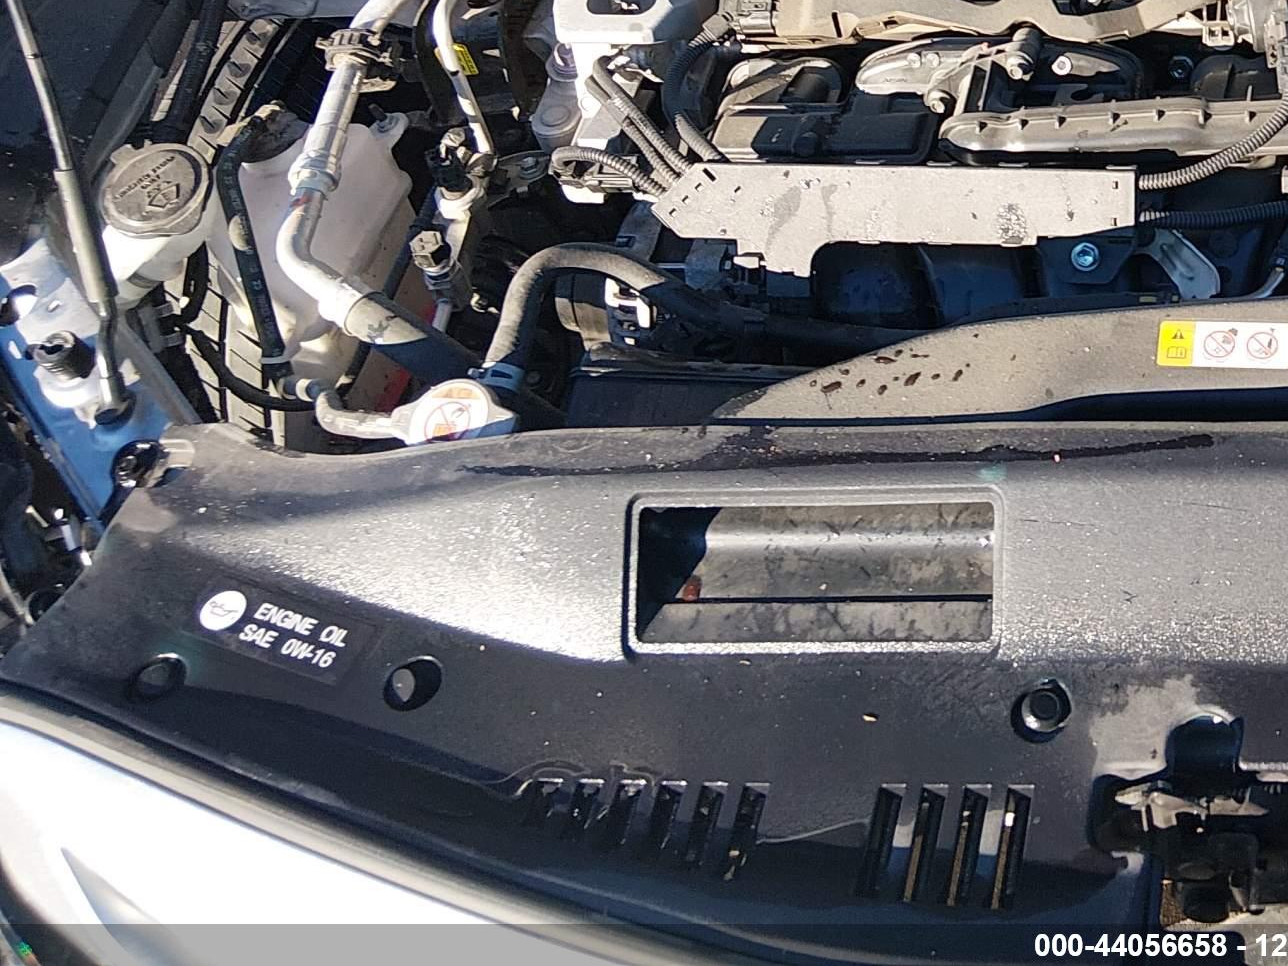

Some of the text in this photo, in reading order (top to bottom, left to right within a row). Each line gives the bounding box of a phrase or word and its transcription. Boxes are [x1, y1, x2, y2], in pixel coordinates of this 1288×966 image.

[238, 624, 337, 668] SAE 0W-16
[253, 602, 349, 648] ENGINE OIL
